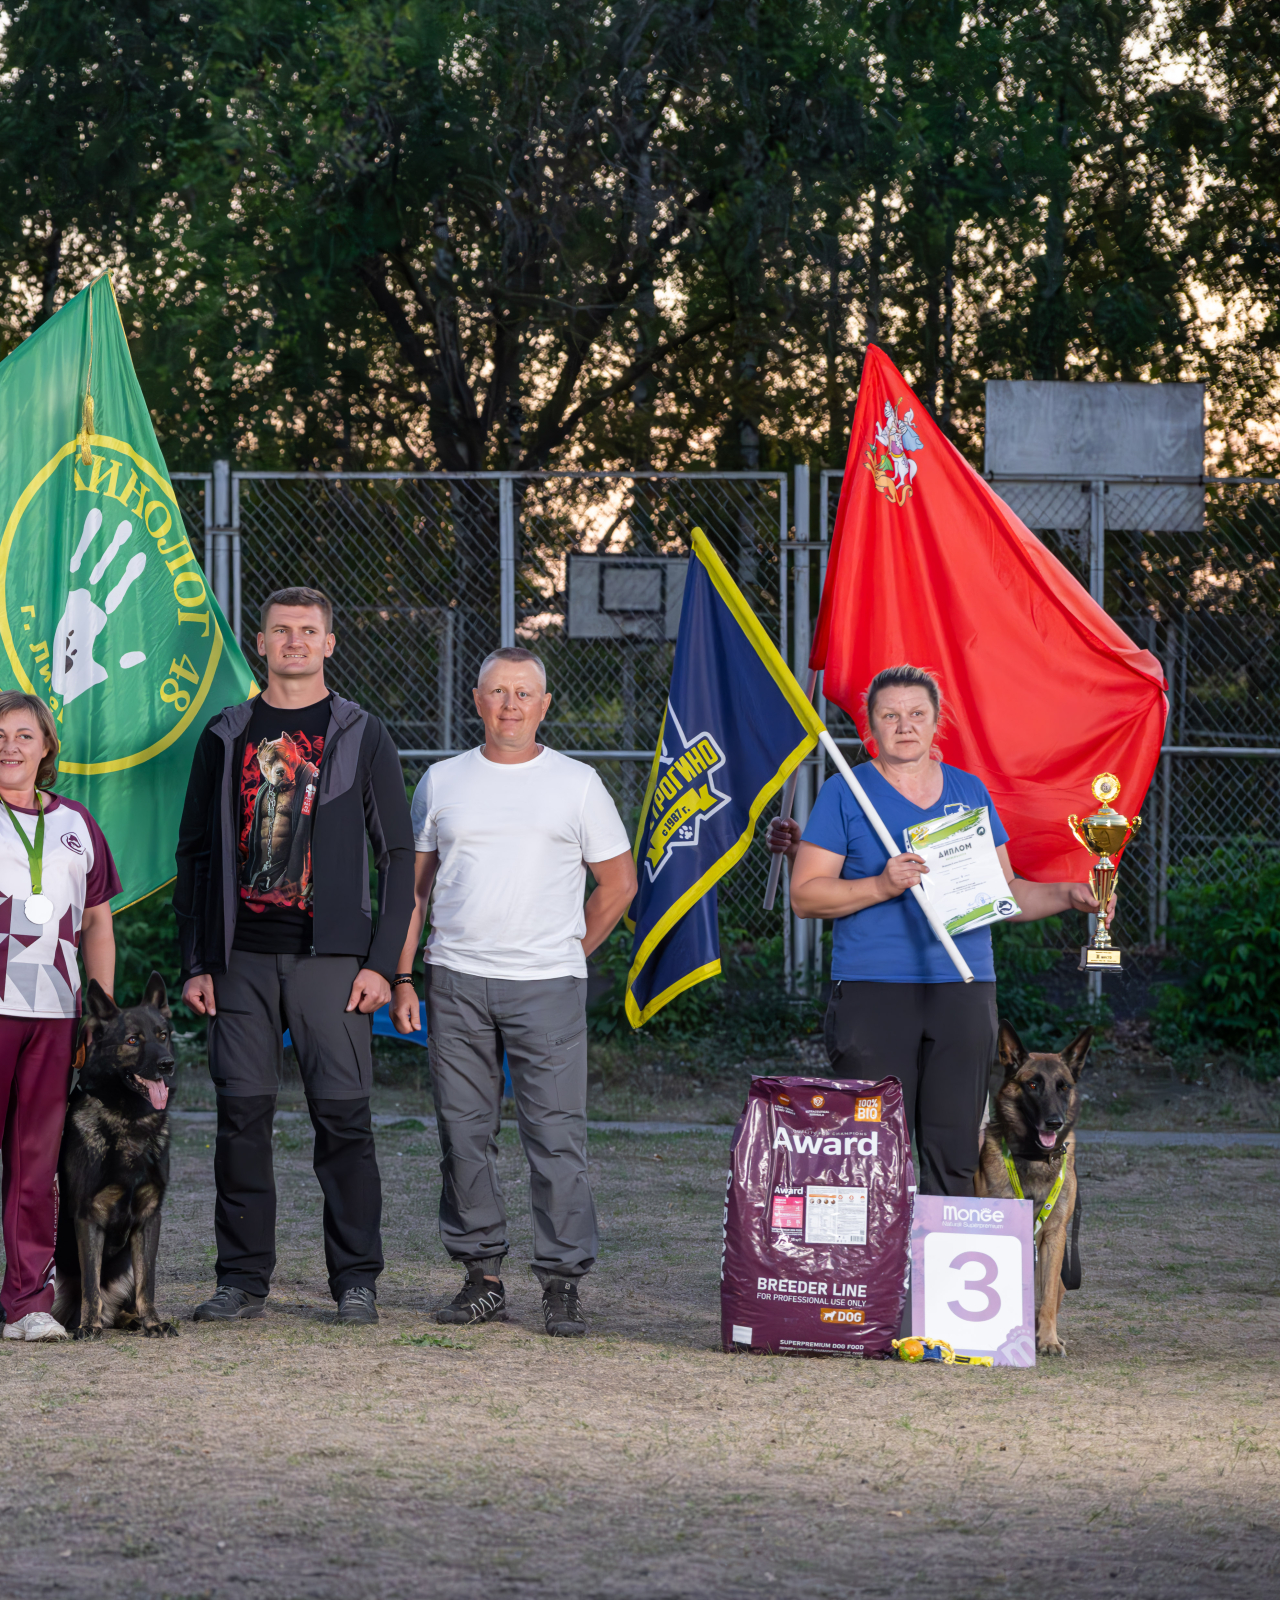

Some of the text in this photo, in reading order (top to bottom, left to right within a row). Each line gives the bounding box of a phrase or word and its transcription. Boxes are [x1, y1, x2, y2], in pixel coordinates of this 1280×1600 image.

[160, 654, 199, 712] 48
[666, 809, 682, 831] 1987
[938, 842, 973, 859] ДИПЛОМ
[858, 1098, 879, 1108] 100%
[857, 1107, 878, 1120] BIO
[772, 1126, 879, 1156] Award
[774, 1185, 804, 1195] Award
[942, 1220, 1004, 1229] Natural Superpremium
[757, 1277, 868, 1298] BREEDER LINE
[946, 1250, 1002, 1323] 3
[756, 1292, 772, 1300] FOR
[773, 1294, 829, 1305] PROFESSIONAL
[830, 1298, 846, 1306] USE
[837, 1311, 862, 1323] DOG
[779, 1339, 831, 1348] SUPERPREMIUM
